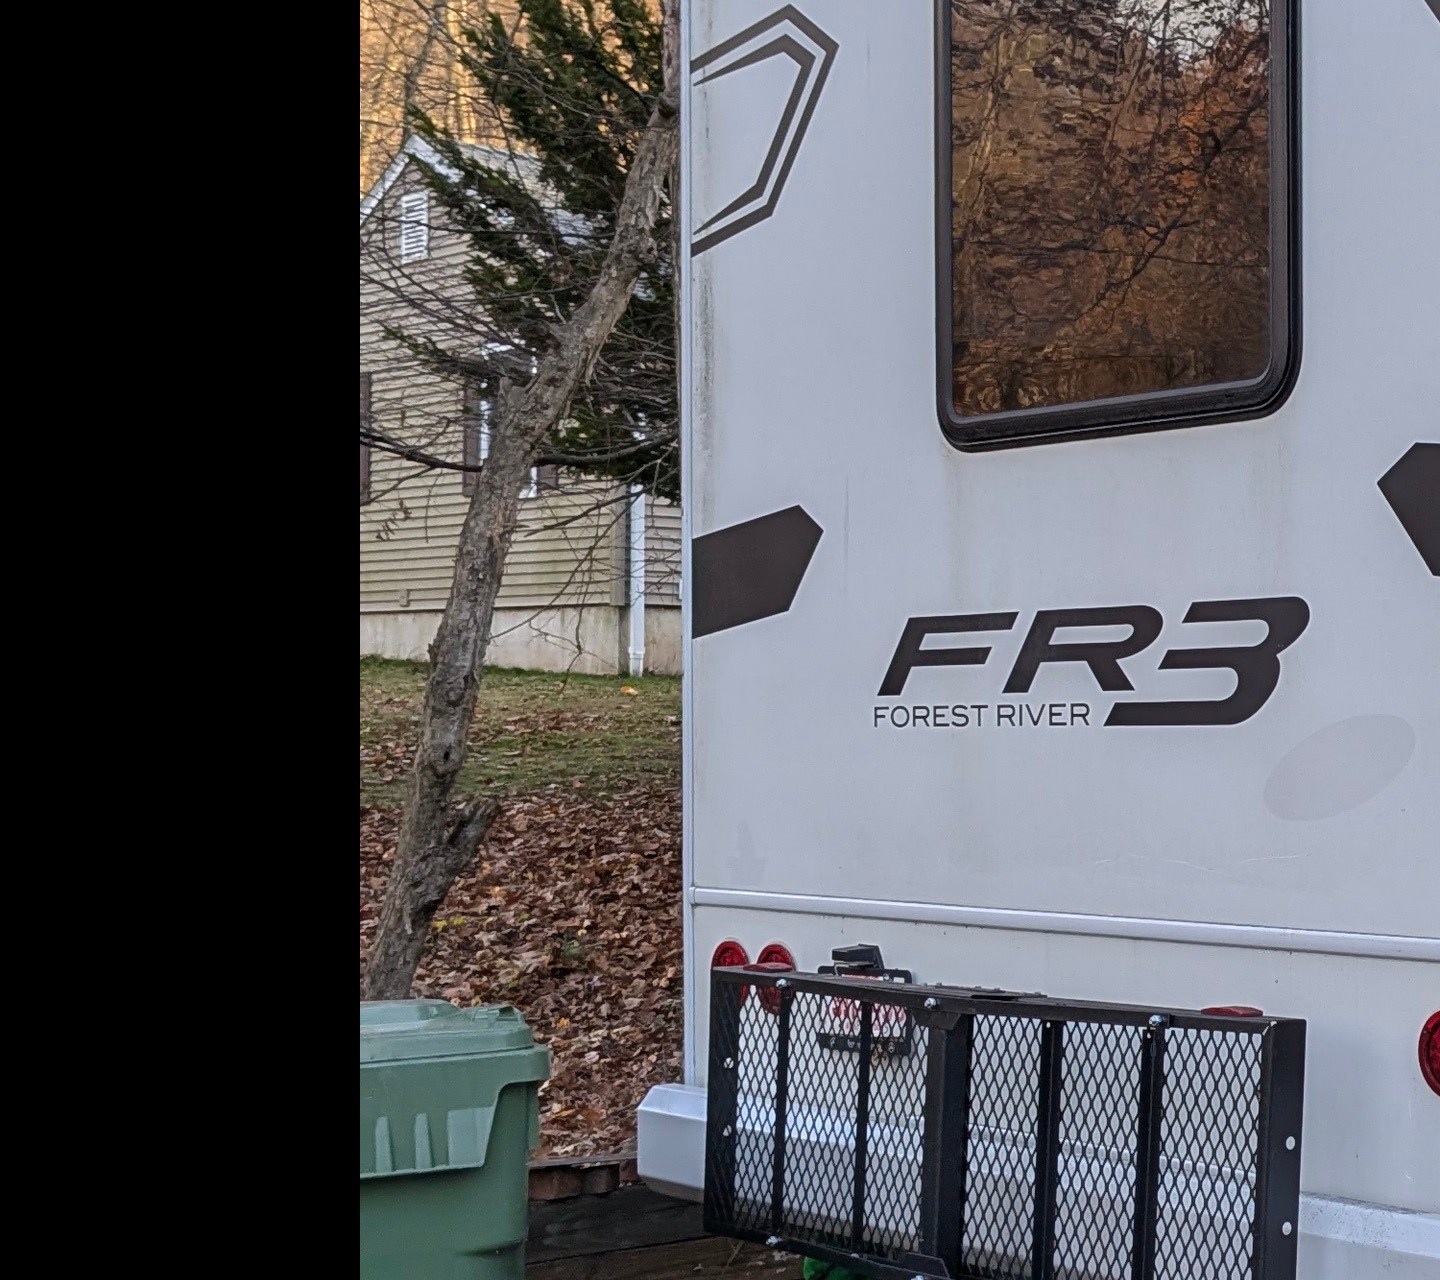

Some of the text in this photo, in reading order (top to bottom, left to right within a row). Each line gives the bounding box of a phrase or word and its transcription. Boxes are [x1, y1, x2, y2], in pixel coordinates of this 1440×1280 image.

[876, 595, 1312, 728] FR3
[873, 703, 1091, 729] FOREST RIVER
